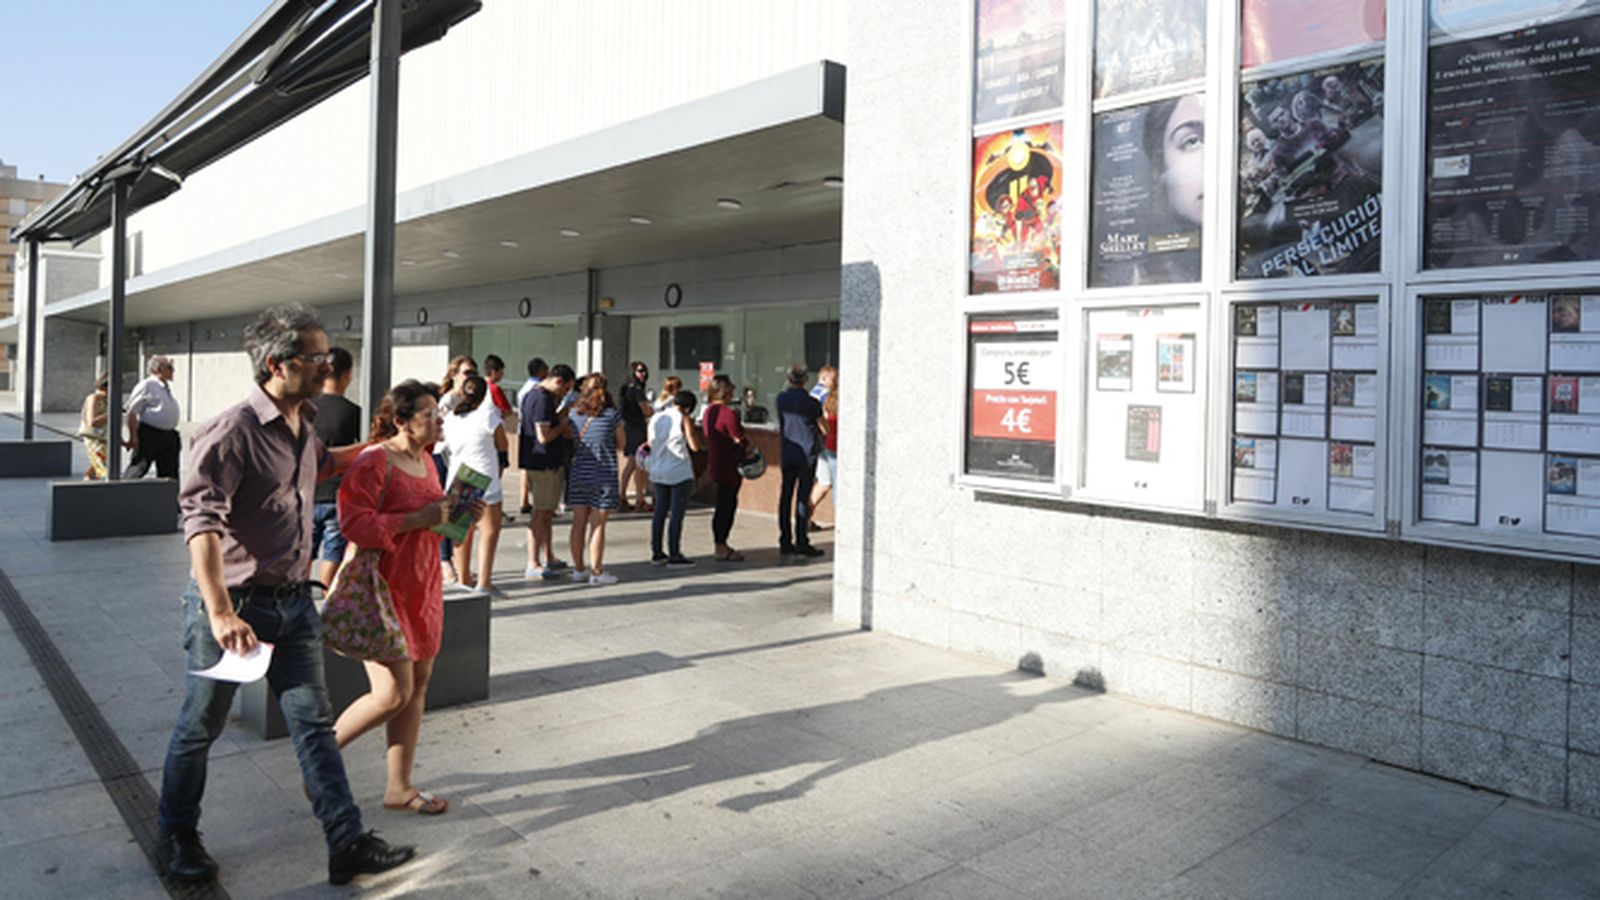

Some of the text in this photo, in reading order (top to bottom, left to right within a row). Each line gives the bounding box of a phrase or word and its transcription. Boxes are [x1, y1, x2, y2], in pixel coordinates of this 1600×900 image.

[1546, 38, 1570, 49] cine
[1484, 58, 1526, 72] entrada
[1004, 361, 1031, 386] 5€
[1000, 407, 1032, 433] 4€
